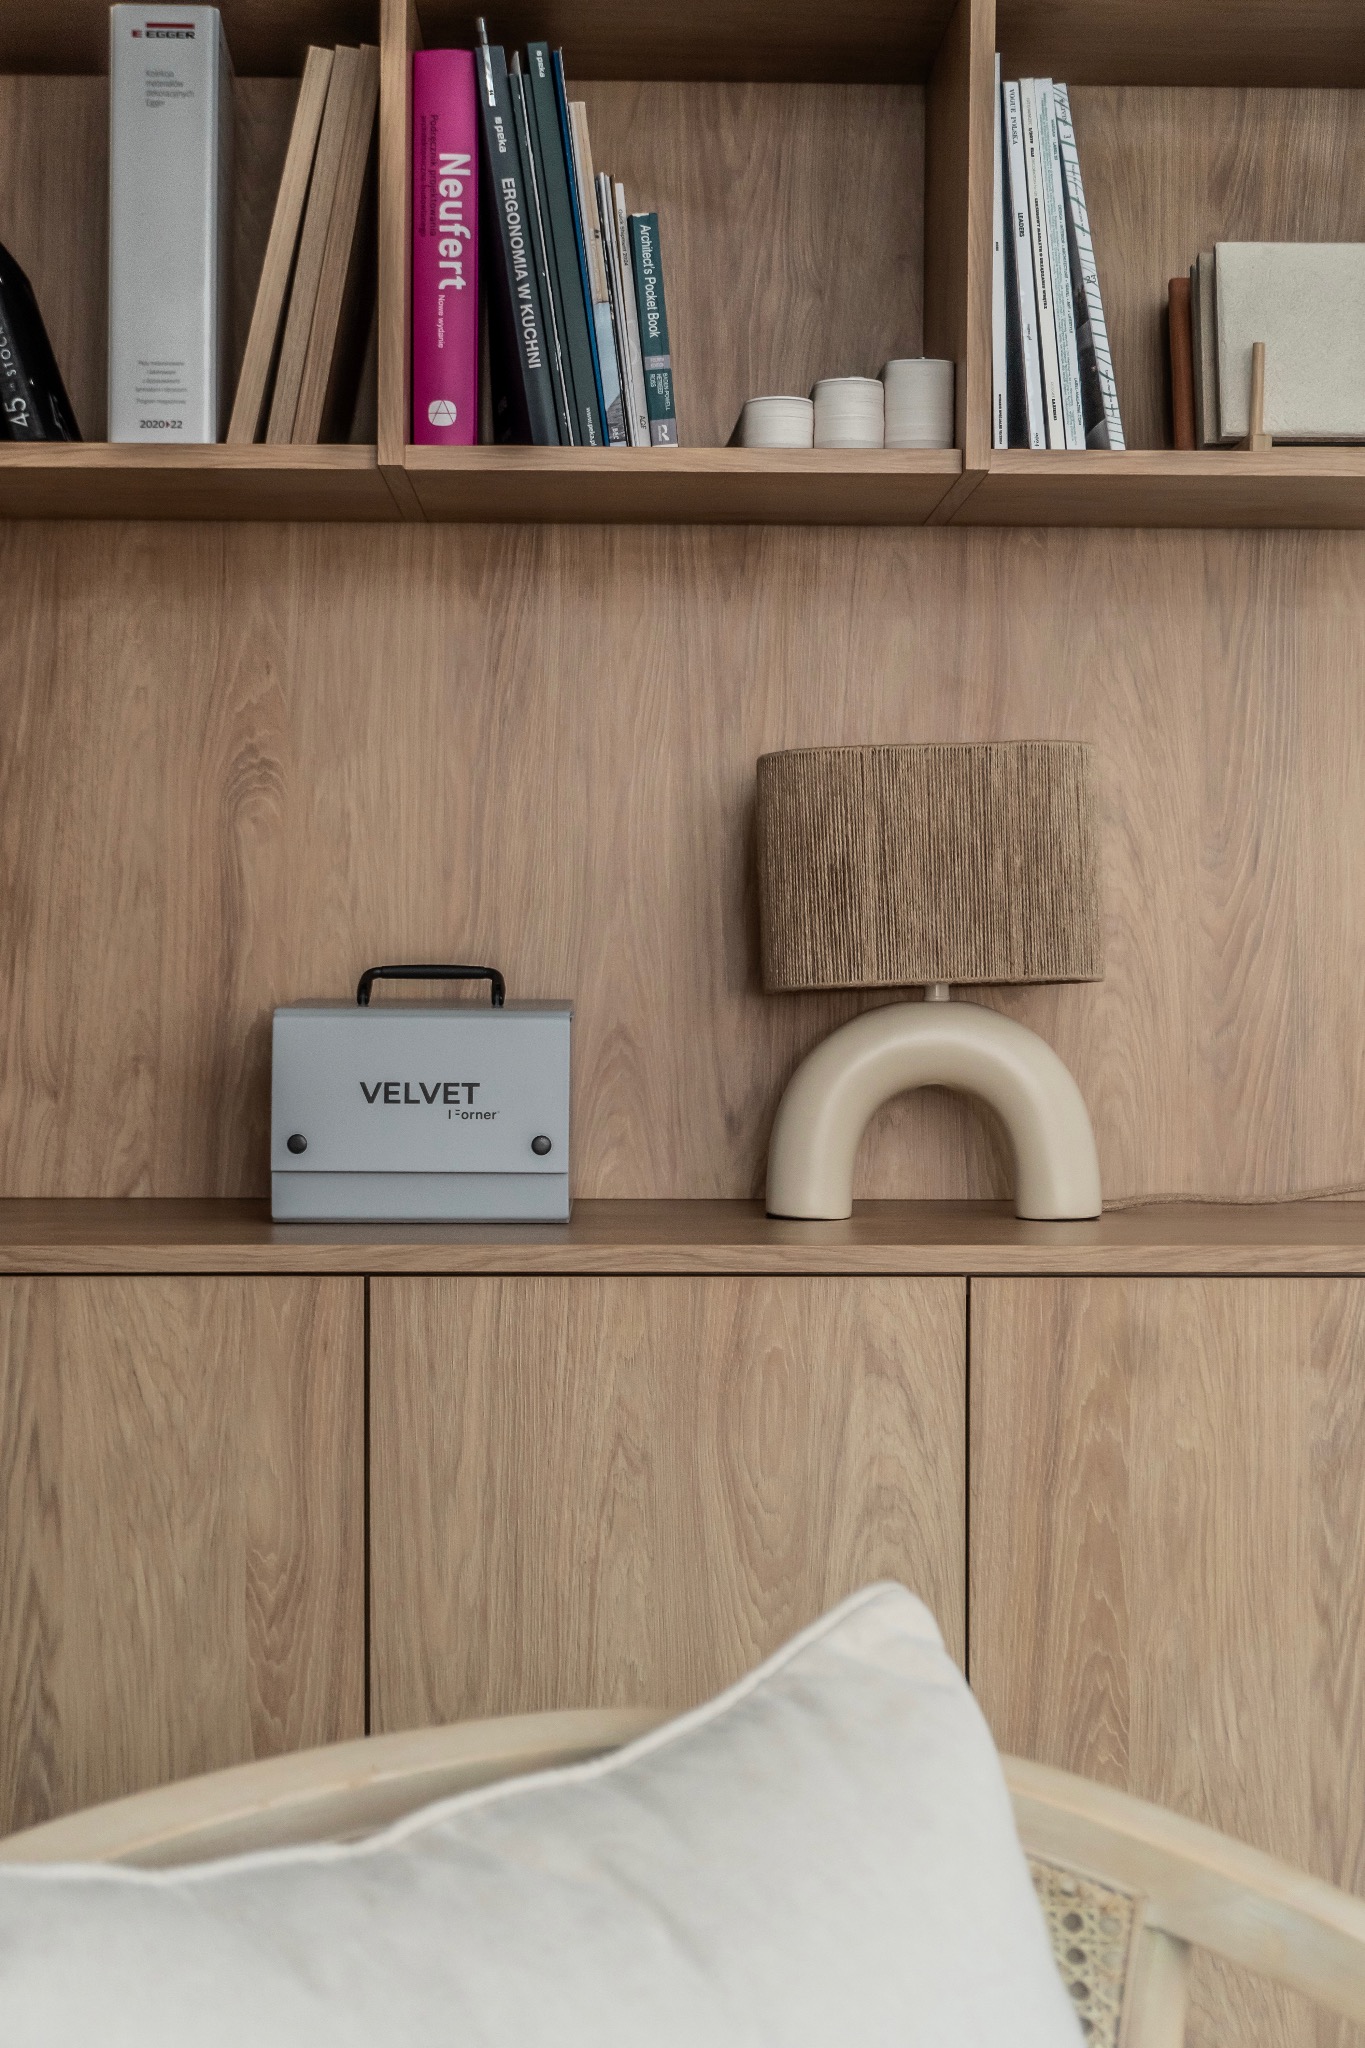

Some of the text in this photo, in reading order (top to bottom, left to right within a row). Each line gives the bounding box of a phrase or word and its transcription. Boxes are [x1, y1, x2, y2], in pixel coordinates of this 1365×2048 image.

[145, 31, 195, 39] EGGER
[537, 57, 546, 78] peka
[494, 125, 507, 154] peka
[428, 170, 437, 236] projektowania
[439, 153, 471, 290] Neufert
[501, 177, 541, 368] ERGONOMIA W KUCHNI
[639, 224, 662, 338] Architect's Pocket Book
[4, 397, 30, 427] 45
[586, 407, 597, 446] www.peka.pl
[359, 1082, 480, 1105] VELVET
